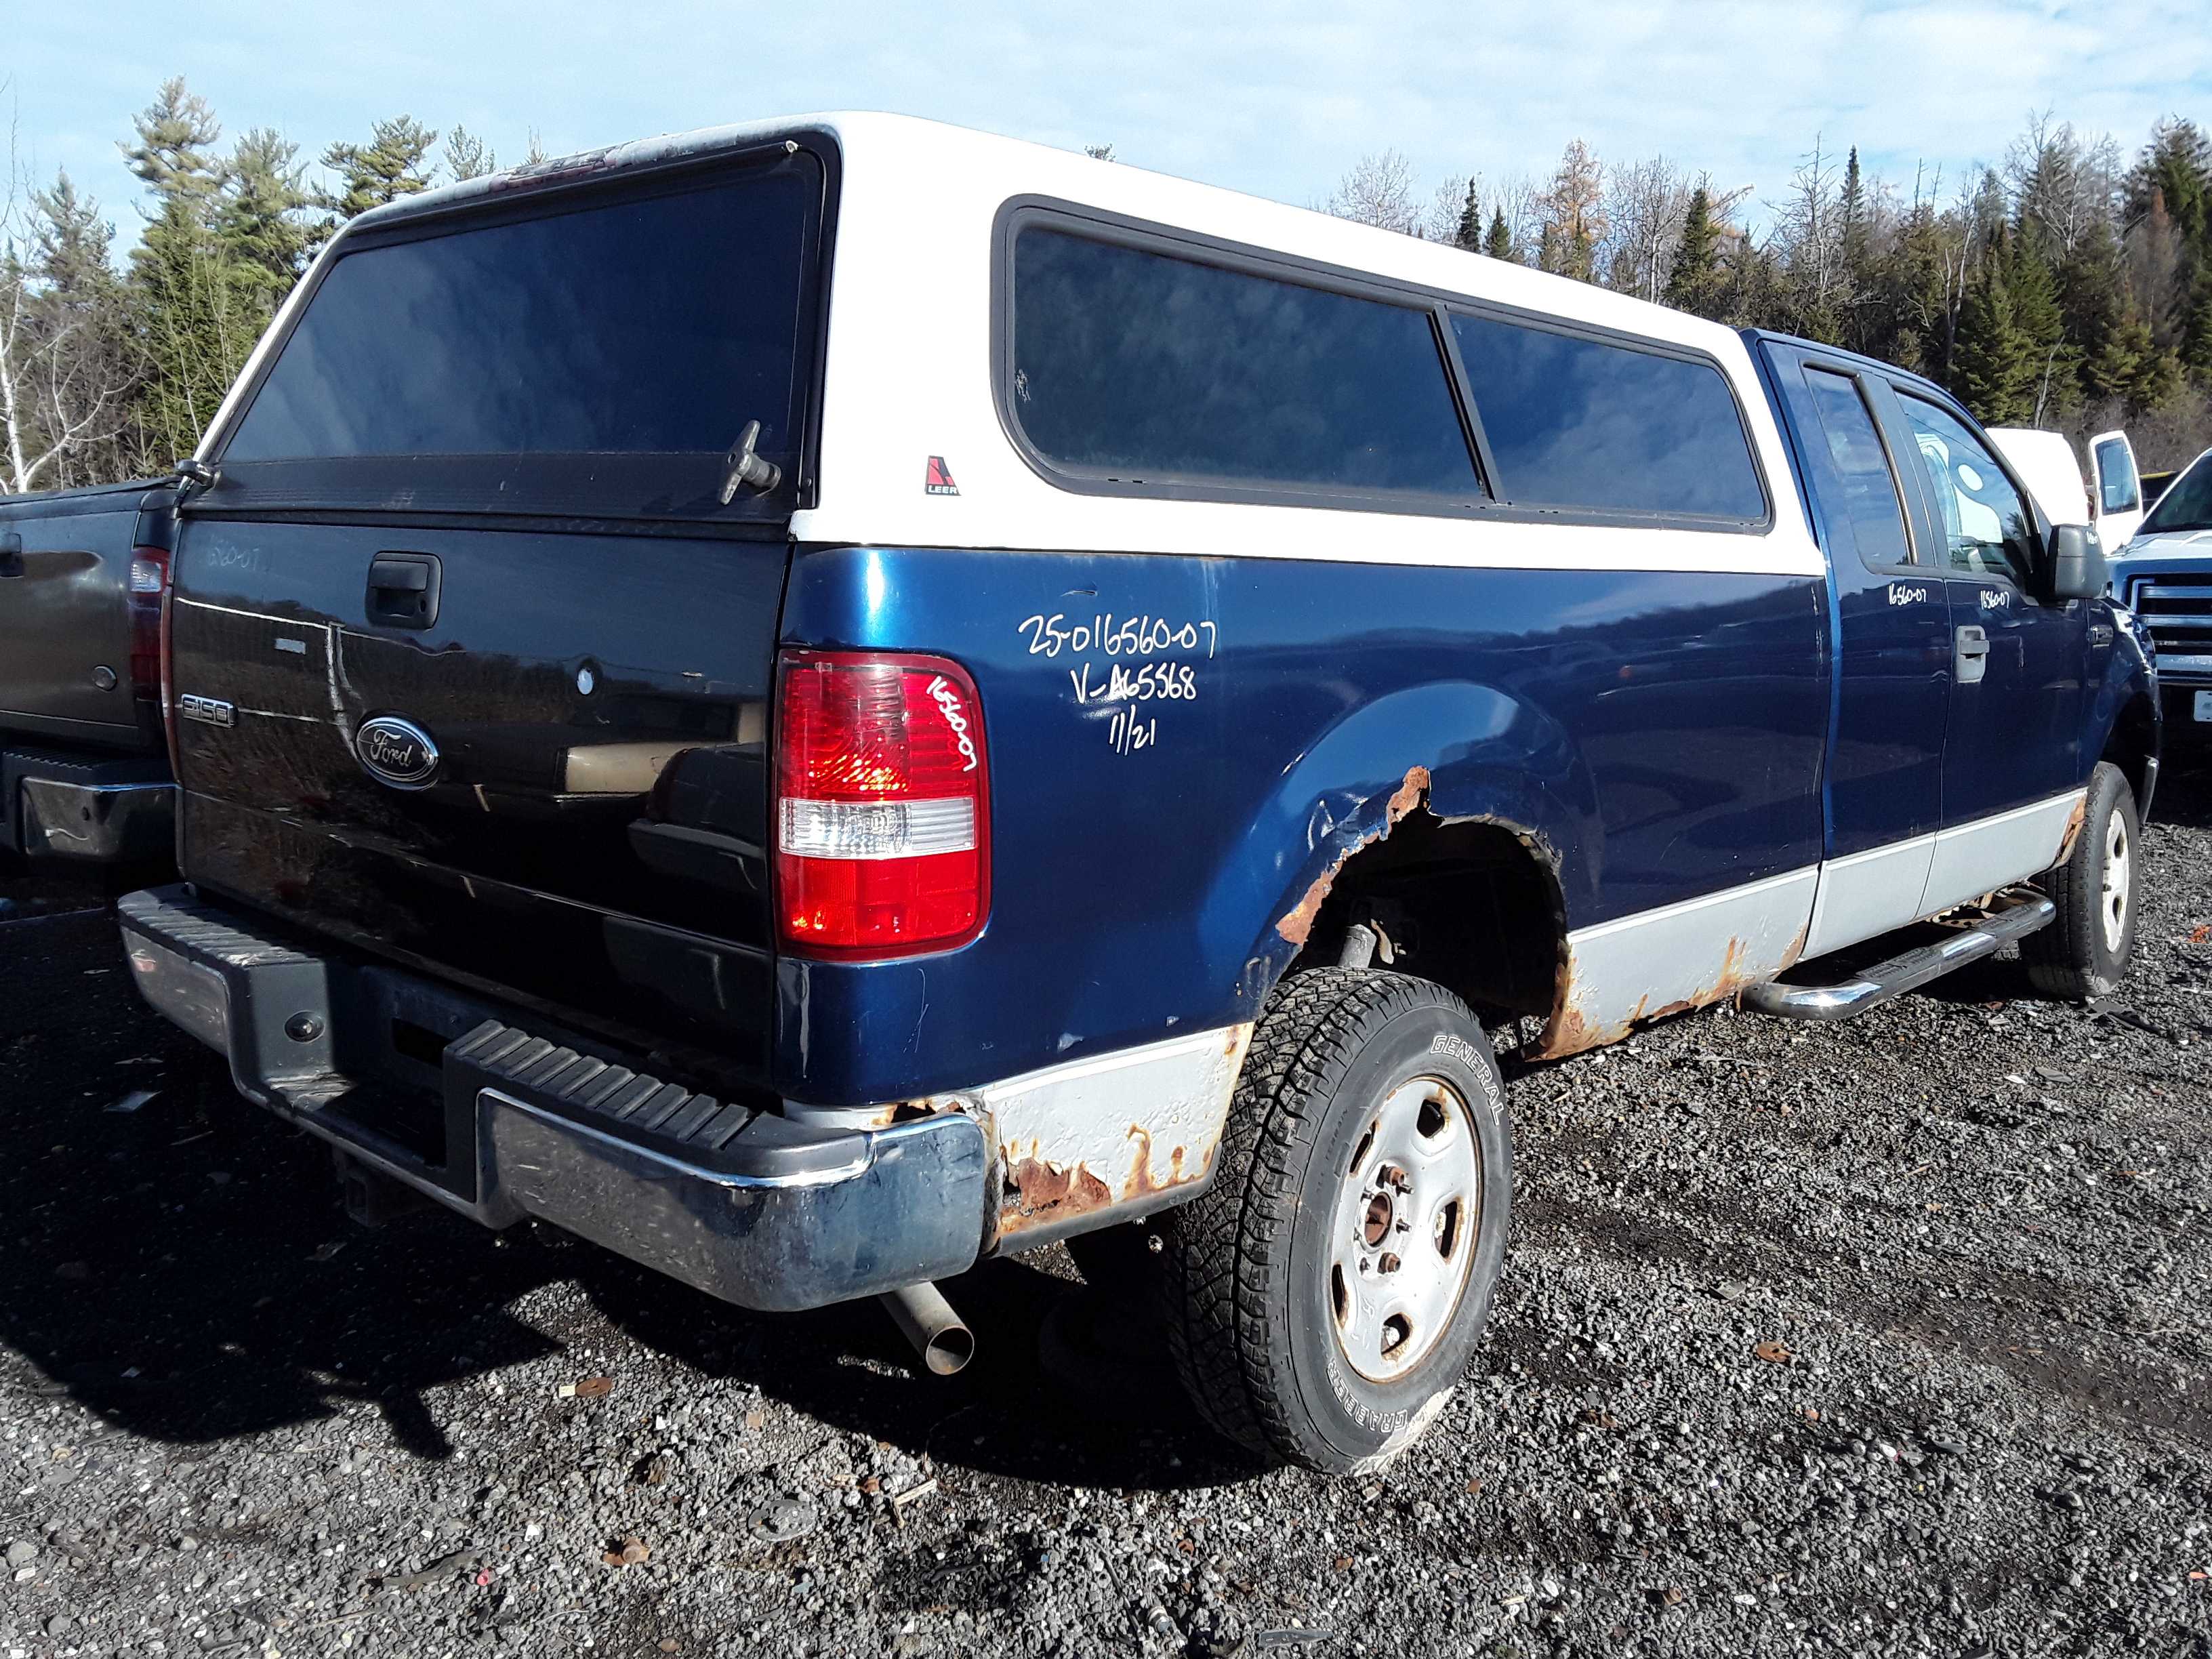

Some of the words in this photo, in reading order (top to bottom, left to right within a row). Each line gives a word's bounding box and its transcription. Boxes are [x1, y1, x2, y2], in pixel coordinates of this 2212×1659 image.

[928, 485, 958, 494] LEER
[1889, 583, 1927, 606] 16560-07
[1018, 613, 1217, 659] 25-016560-07
[369, 729, 413, 767] Ford
[1109, 704, 1156, 756] 11/21
[1429, 1035, 1504, 1126] GENERAL
[1326, 1357, 1408, 1433] GRABBER
